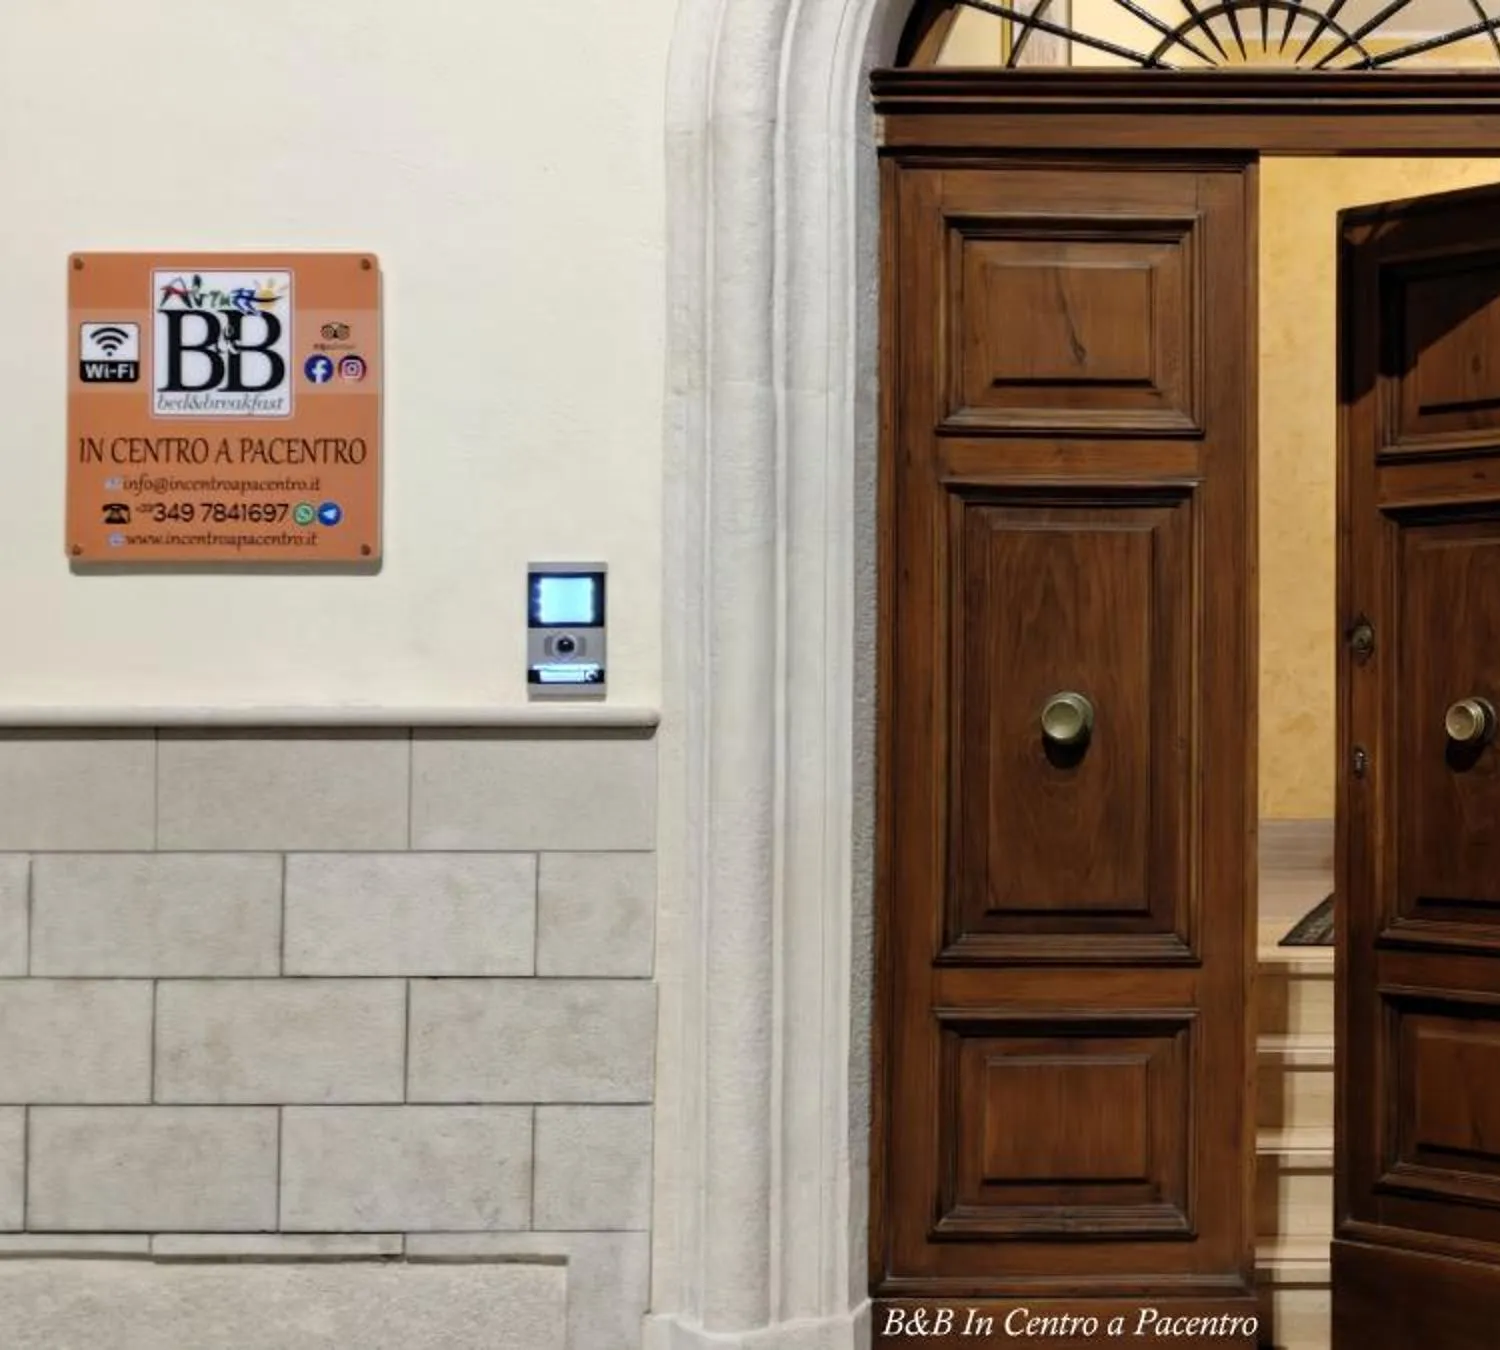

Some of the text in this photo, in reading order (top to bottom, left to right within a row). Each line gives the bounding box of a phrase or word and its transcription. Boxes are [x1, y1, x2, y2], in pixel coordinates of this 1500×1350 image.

[84, 363, 135, 379] Wi-Fi
[157, 393, 284, 413] bed&breakfast
[79, 437, 367, 465] IN CENTRO A PACENTRO
[122, 474, 321, 496] info@incentroapacentro.it
[200, 502, 289, 523] 7841697
[126, 532, 318, 550] www.incentroapacentro.it
